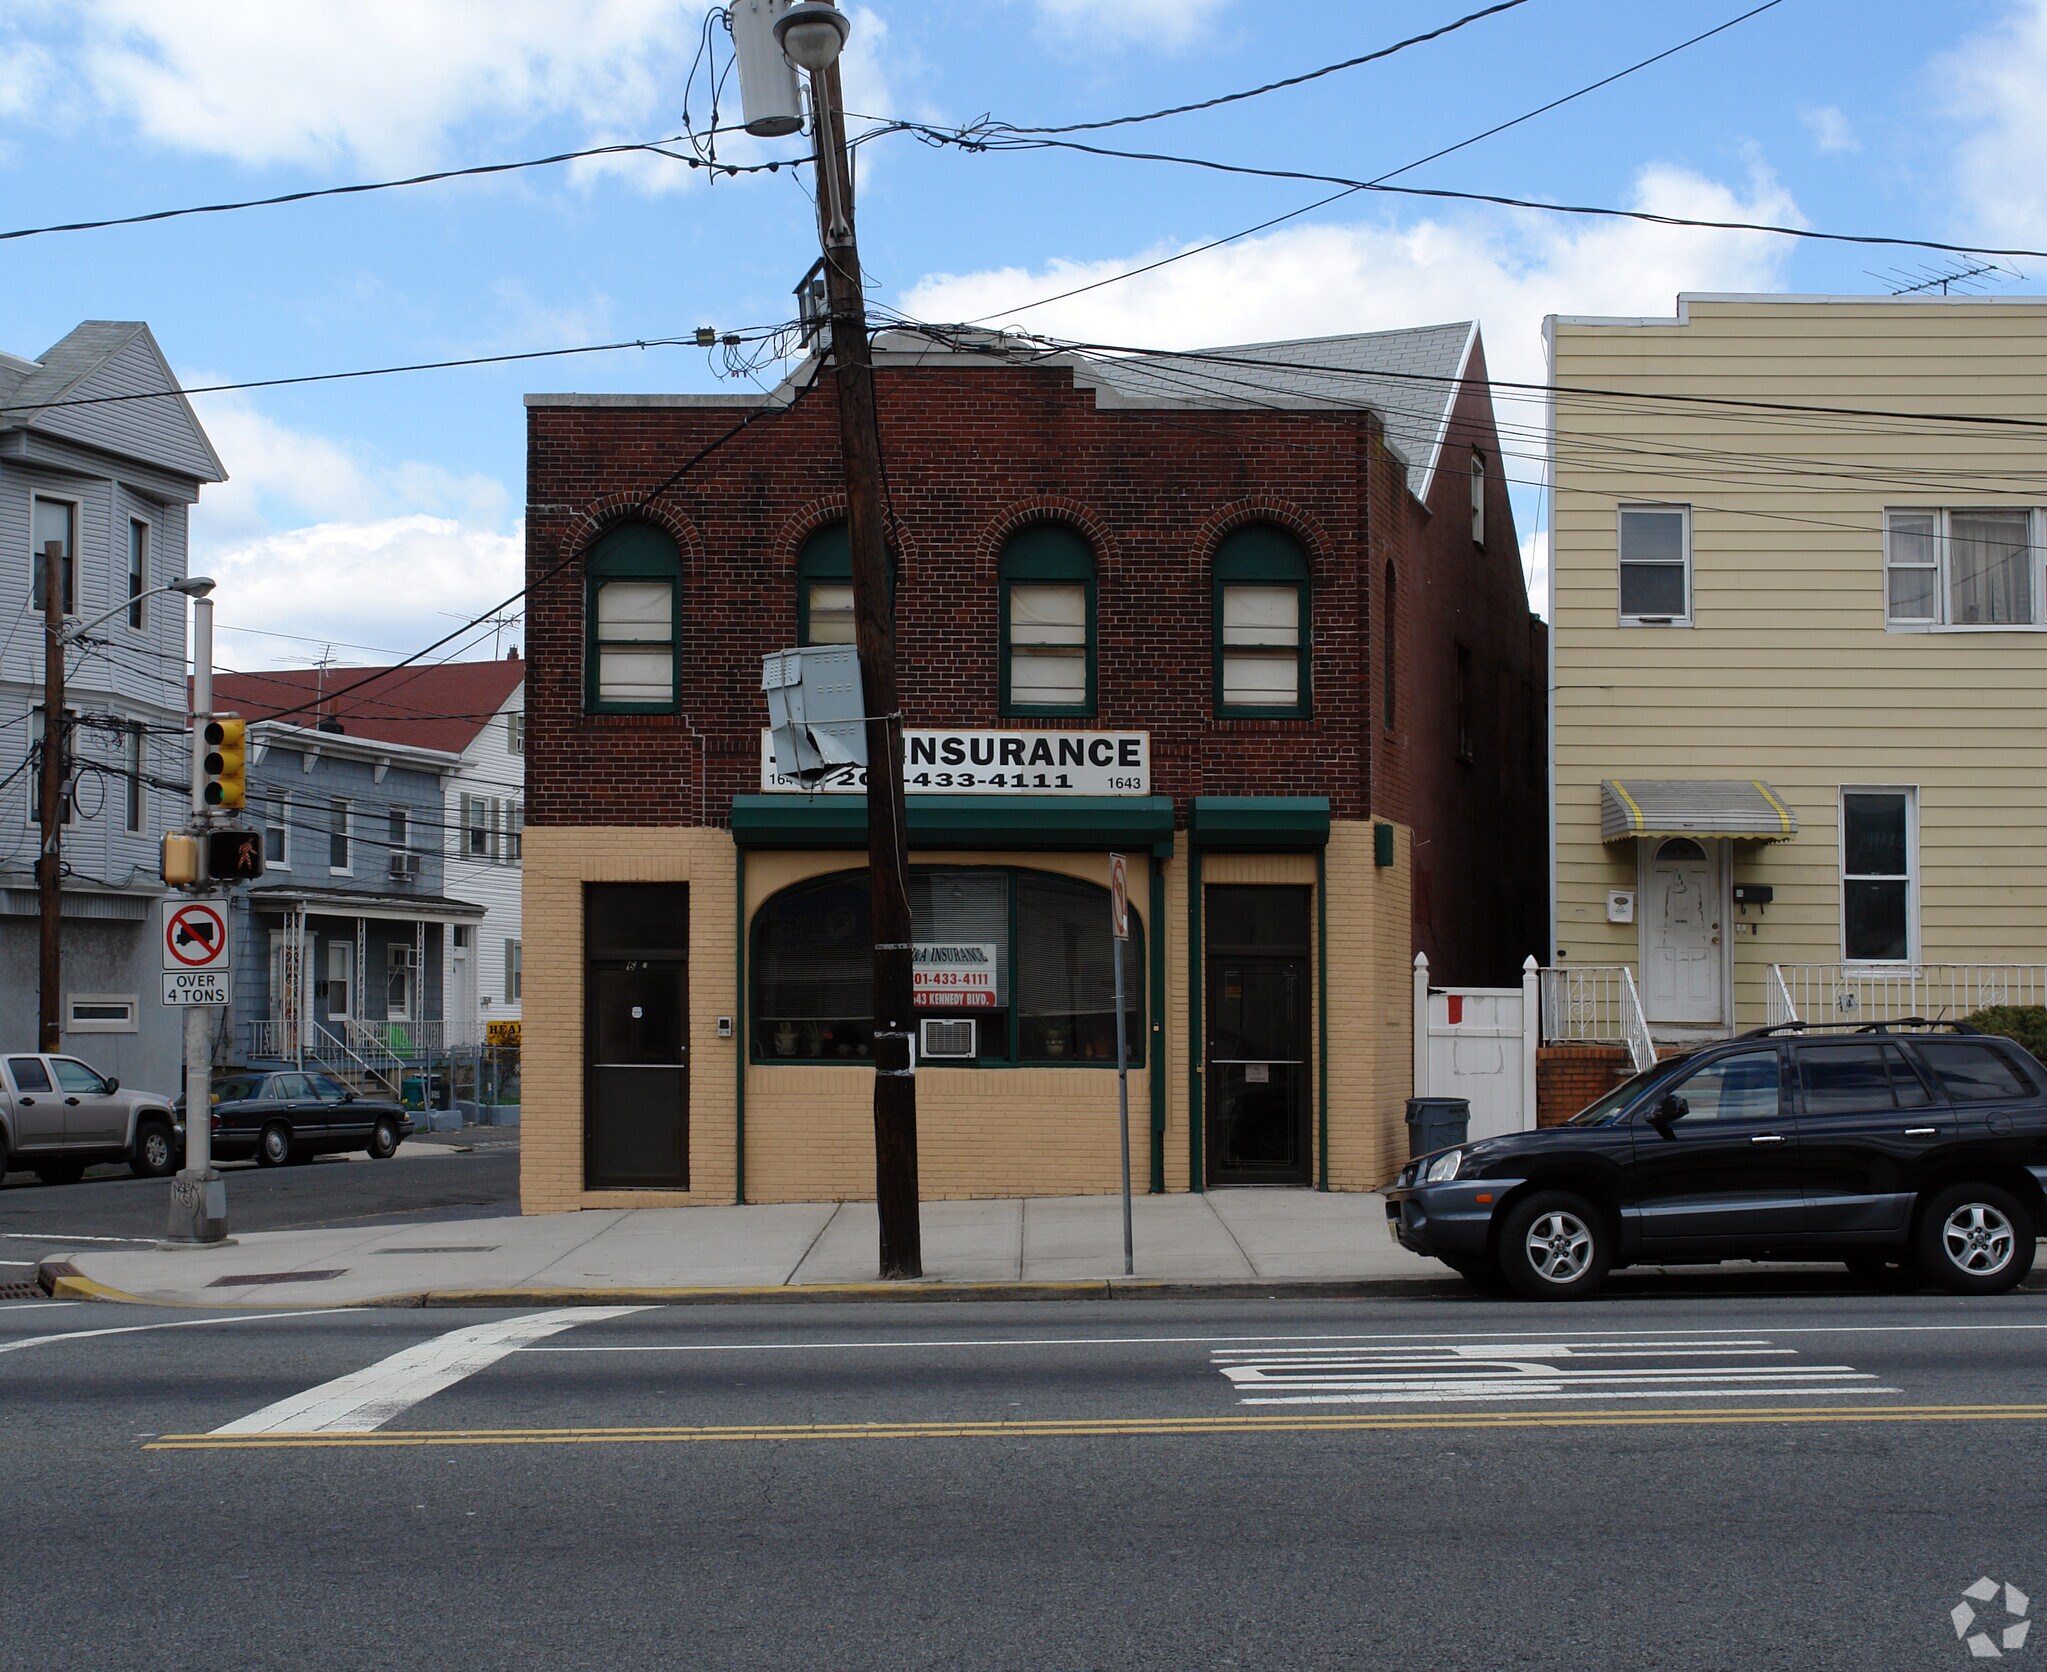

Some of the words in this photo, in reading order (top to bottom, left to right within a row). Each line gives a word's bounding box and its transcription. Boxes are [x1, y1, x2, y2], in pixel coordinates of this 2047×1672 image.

[903, 737, 1141, 767] NSURANCE
[1107, 777, 1141, 790] 1643
[930, 947, 989, 962] INSURANCE
[176, 975, 215, 988] OVER
[913, 973, 988, 985] 01-433-4111
[168, 989, 177, 1002] 4
[183, 989, 225, 1002] TONS
[929, 993, 964, 1005] KENNEDY
[967, 993, 989, 1005] BLVD.
[1209, 1340, 1905, 1405] MPH
